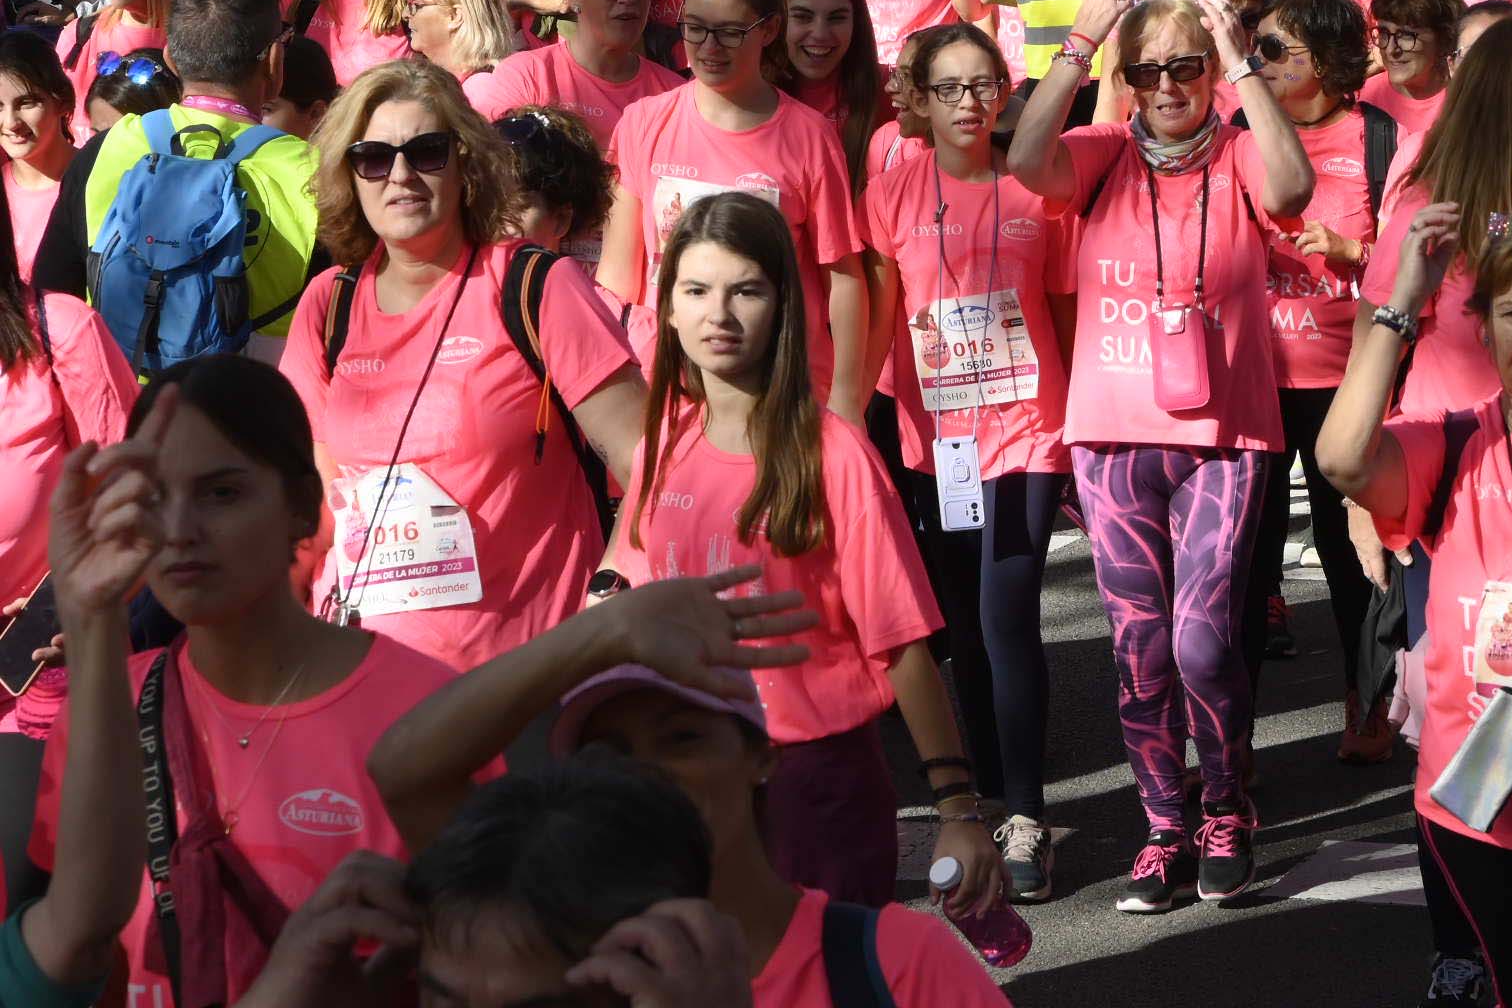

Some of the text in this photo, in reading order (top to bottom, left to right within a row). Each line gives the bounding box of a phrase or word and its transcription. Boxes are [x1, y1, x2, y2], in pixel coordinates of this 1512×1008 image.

[1098, 259, 1136, 287] TU
[953, 337, 995, 357] 016
[374, 521, 419, 545] 016
[379, 548, 415, 565] 21179
[383, 569, 394, 580] DE
[395, 567, 407, 578] LA
[408, 565, 439, 577] MUJER
[442, 561, 464, 571] 2023
[420, 581, 470, 597] Santander
[141, 763, 161, 792] TO
[145, 797, 166, 843] YOU
[286, 803, 361, 828] ASTURIANA
